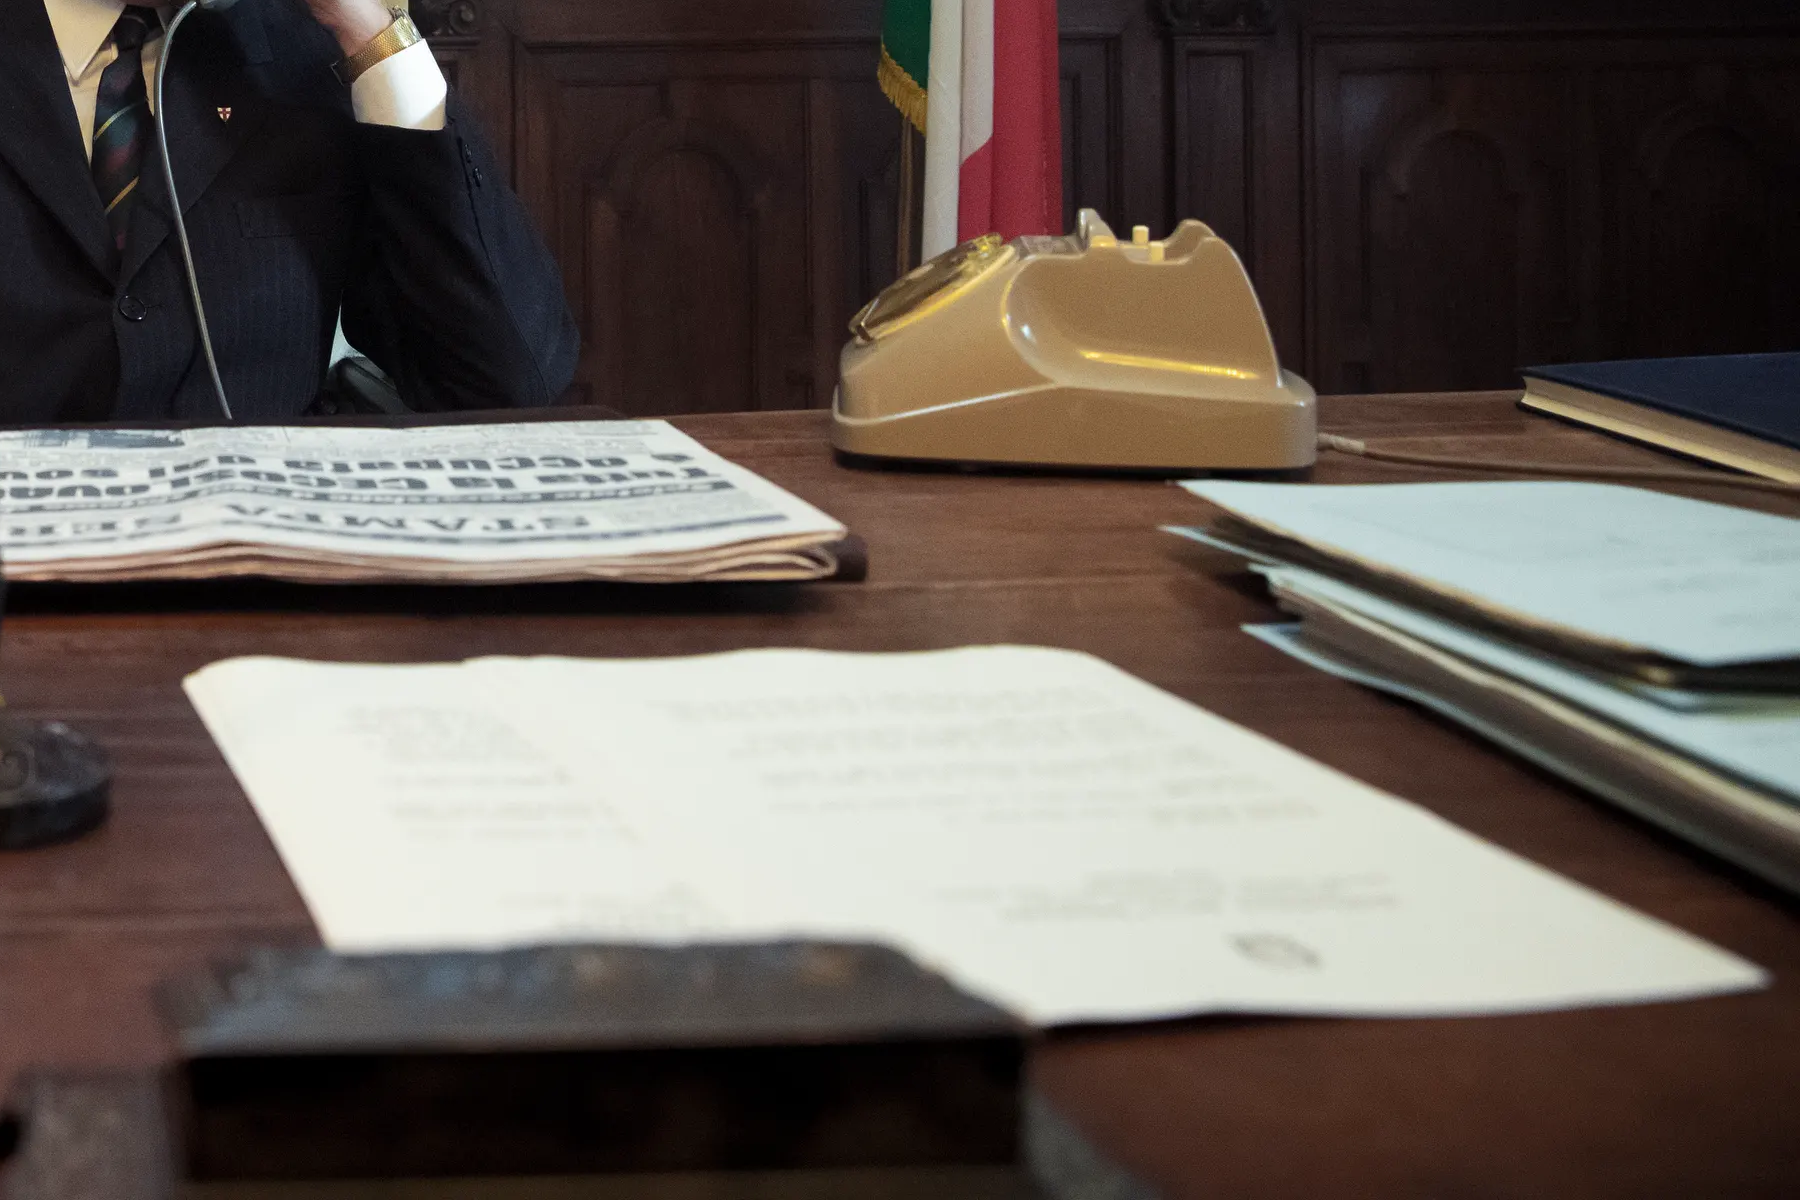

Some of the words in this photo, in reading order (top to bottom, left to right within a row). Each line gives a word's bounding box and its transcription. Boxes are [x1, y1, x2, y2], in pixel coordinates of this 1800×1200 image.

[148, 454, 255, 477] dai
[283, 455, 627, 473] occupata
[447, 476, 515, 490] la
[535, 466, 713, 484] Tutta
[226, 502, 588, 532] STAMPA
